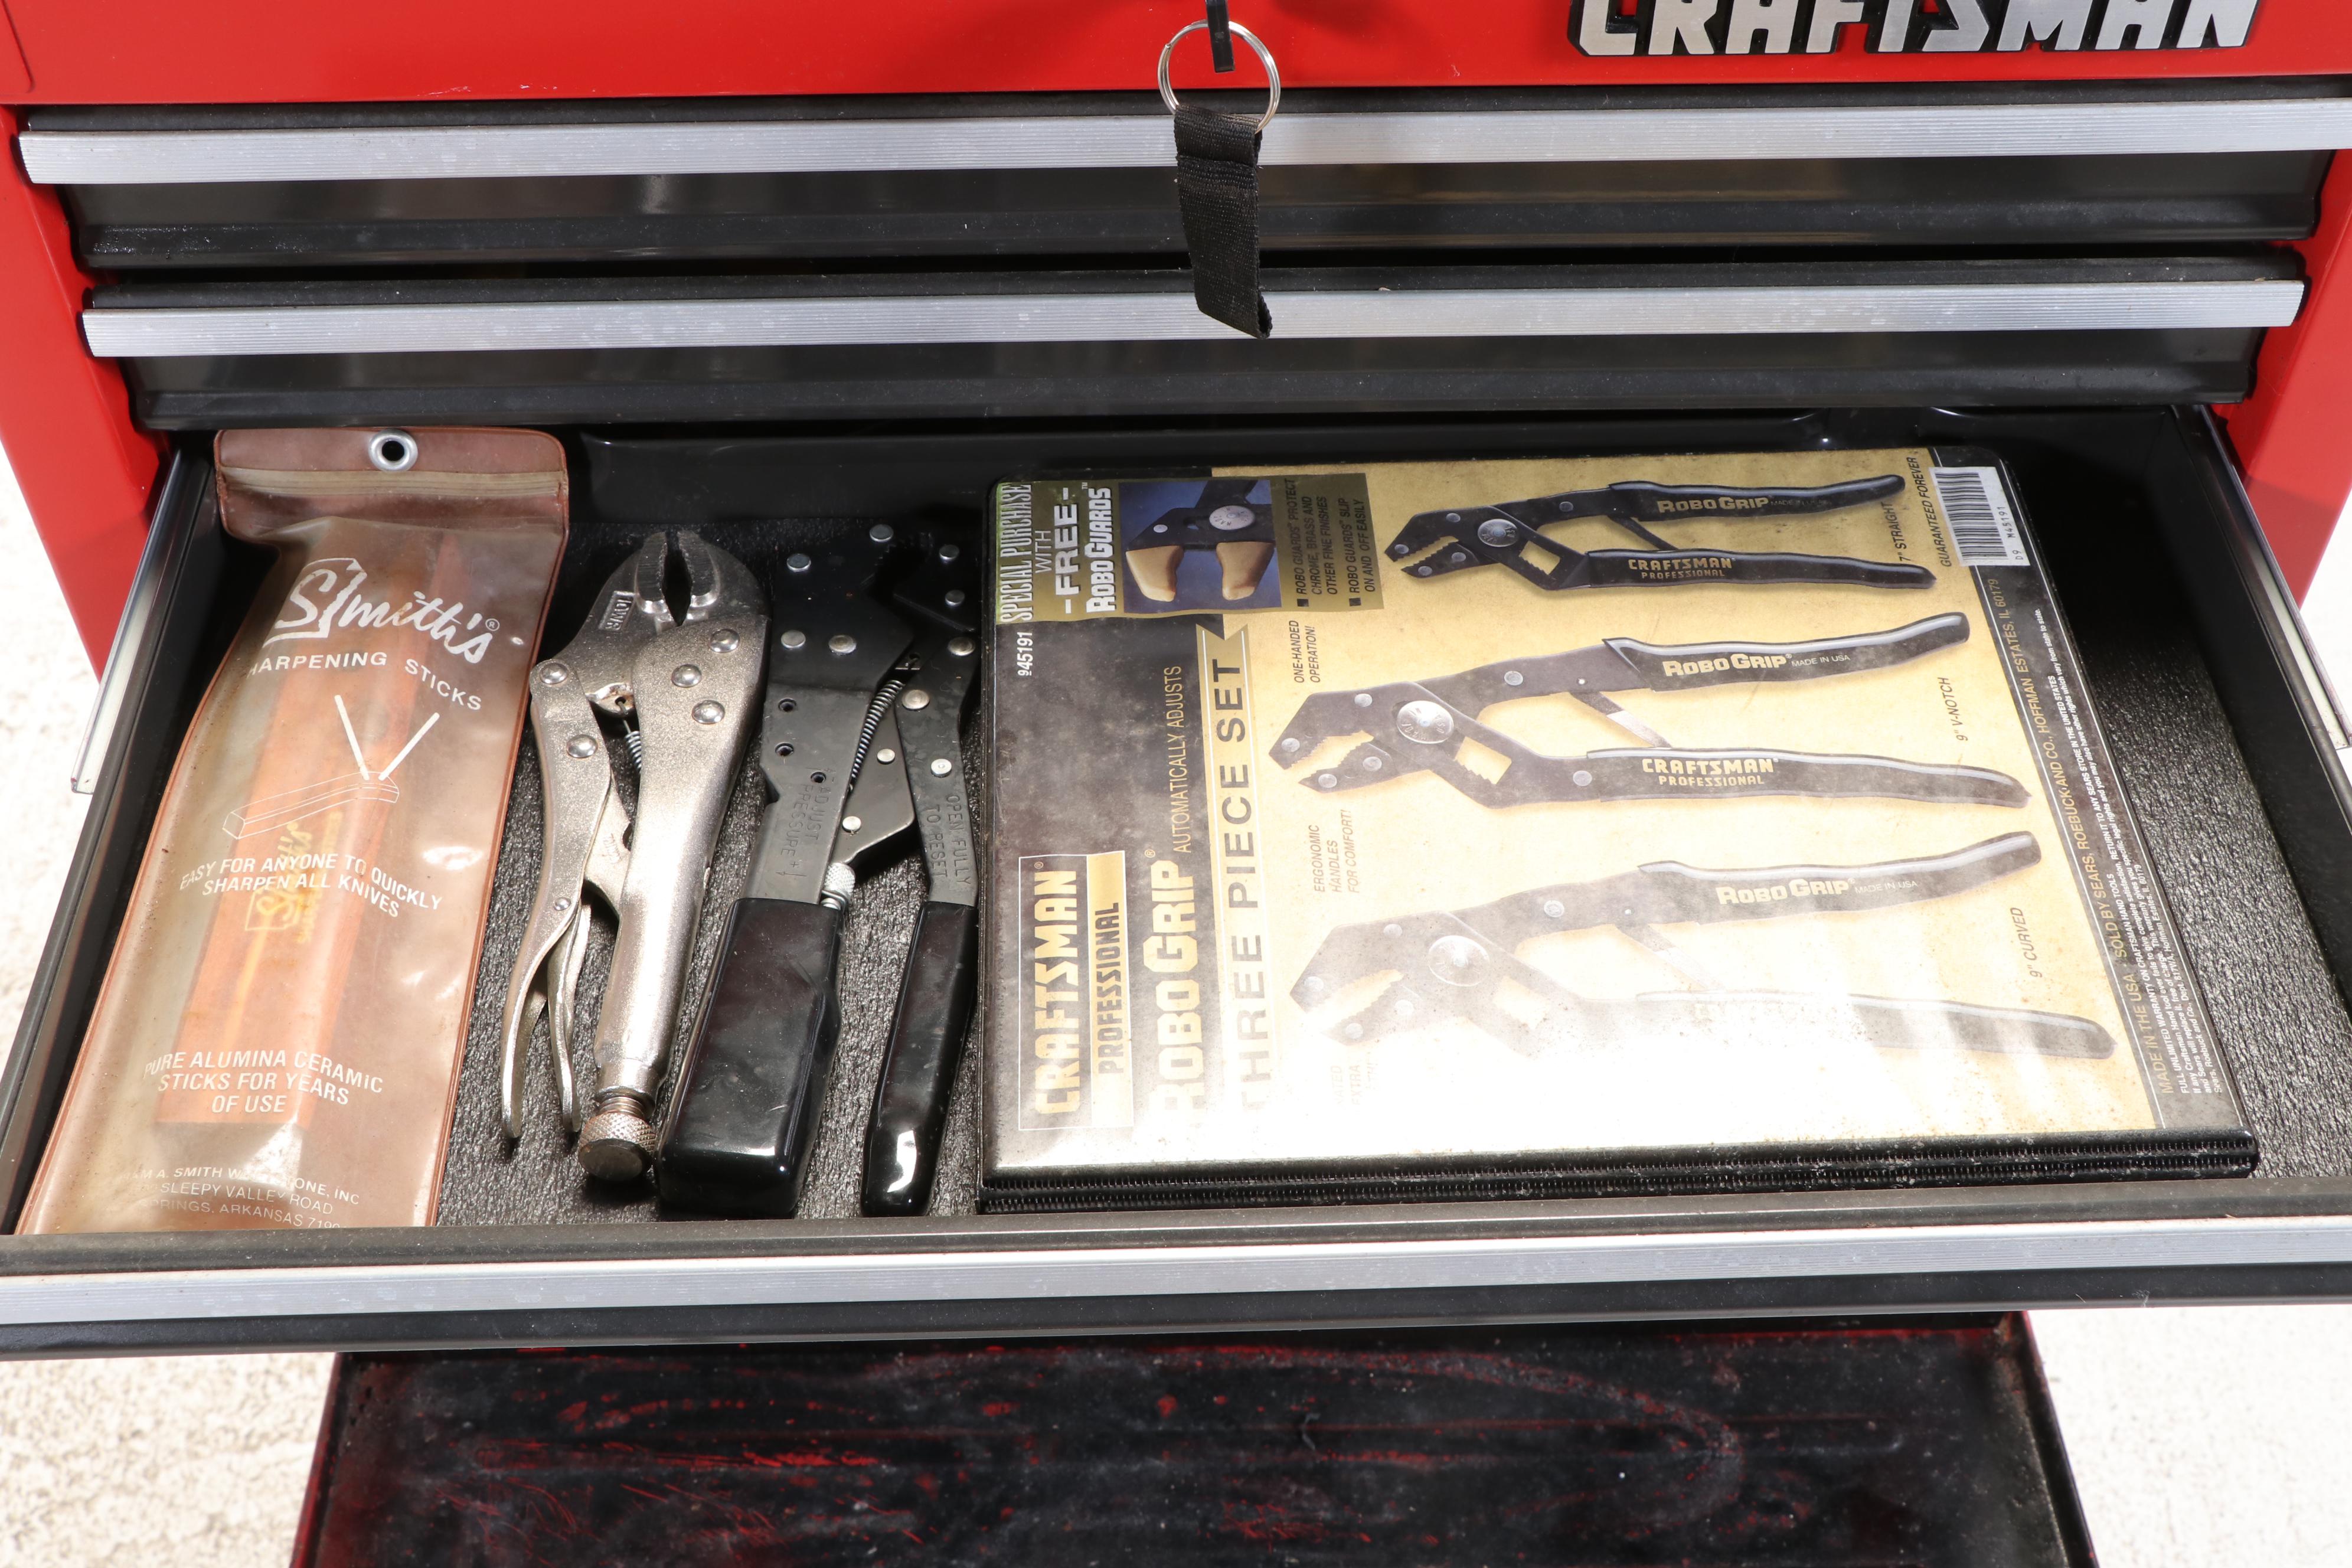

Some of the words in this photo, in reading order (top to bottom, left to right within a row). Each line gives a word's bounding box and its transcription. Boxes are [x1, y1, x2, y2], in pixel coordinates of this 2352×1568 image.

[1570, 0, 2256, 56] CRAFTSMAN
[1906, 457, 1930, 498] FOREVER
[1285, 478, 1298, 520] PROTECT
[1302, 496, 1313, 516] AND
[1338, 498, 1350, 518] SLIP
[1353, 499, 1367, 531] EASILY
[1001, 482, 1032, 557] PURCHASE
[1084, 488, 1113, 558] GUARDS
[1317, 496, 1331, 536] FINISHES
[1883, 502, 1907, 550] STRAIGHT
[1998, 506, 2016, 538] M45191
[1304, 518, 1317, 550] BRASS
[1321, 538, 1334, 560] FINE
[1358, 533, 1370, 551] OFF
[1922, 500, 1952, 567] GUARANTEED
[1035, 531, 1052, 573] WITH
[1361, 556, 1374, 576] AND
[1628, 558, 1733, 571] CRAFTSMAN
[2013, 550, 2024, 560] D9
[1086, 560, 1116, 613] ROBO
[1294, 568, 1307, 595] ROBO
[1308, 553, 1322, 595] CHROME,
[1325, 563, 1338, 594] OTHER
[1347, 566, 1360, 593] ROBO
[1364, 578, 1376, 592] ON
[1641, 570, 1725, 579] PROFESSIONAL
[1000, 560, 1033, 623] SPECIAL
[1988, 579, 2005, 606] 60179
[264, 558, 493, 664] Smith's
[1017, 632, 1033, 676] 945191
[1289, 620, 1305, 683] ONE-HANDED
[1304, 626, 1321, 683] OPERATION!
[1792, 658, 1818, 667] MADE
[1831, 654, 1851, 662] USA
[2003, 624, 2028, 672] ESTATES,
[247, 652, 387, 677] HARPENING
[405, 659, 481, 711] STICKS
[1164, 665, 1184, 729] ADJUSTS
[2047, 675, 2062, 700] STATES
[1212, 659, 1246, 743] SET
[1938, 677, 1963, 726] V-NOTCH
[2021, 678, 2049, 732] HOFFMAN
[2057, 701, 2070, 724] UNITED
[1954, 729, 1968, 741] 9"
[2065, 727, 2075, 739] THE
[1642, 758, 1774, 775] CRAFTSMAN
[2050, 762, 2067, 786] AND
[2073, 749, 2087, 770] STORE
[1167, 733, 1191, 854] AUTOMATICALLY
[1658, 776, 1765, 787] PROFESSIONAL
[2082, 772, 2095, 795] SEARS
[780, 784, 814, 856] PRESSURE
[805, 787, 831, 840] ADJUST
[926, 804, 941, 823] TO
[946, 795, 964, 830] OPEN
[2059, 790, 2089, 848] ROEBUCK
[2090, 797, 2101, 811] ANY
[2096, 812, 2105, 821] TO
[1220, 764, 1258, 908] PIECE
[1340, 809, 1358, 867] COMFORT!
[2102, 831, 2118, 859] RETURN
[929, 833, 948, 877] RESET
[953, 840, 971, 884] FULLY
[1308, 825, 1326, 893] ERGONOMIC
[1328, 839, 1342, 893] HANDLES
[180, 861, 215, 890] EASY
[220, 858, 256, 874] FOR
[260, 854, 338, 872] ANYONE
[344, 855, 367, 876] TO
[371, 867, 443, 910] QUICKLY
[1347, 868, 1360, 894] FOR
[1854, 884, 1883, 894] MADE
[1884, 882, 1896, 890] IN
[1898, 880, 1917, 888] USA
[2082, 855, 2106, 897] SEARS,
[2106, 874, 2120, 897] TOOLS
[2134, 864, 2147, 884] 60179
[202, 874, 290, 896] SHARPEN
[295, 873, 331, 888] ALL
[338, 874, 399, 918] KNIVES
[2098, 902, 2113, 918] BY
[2115, 899, 2128, 919] HAND
[1143, 860, 1198, 972] GRIP
[2129, 903, 2145, 934] complete
[2010, 907, 2037, 962] CURVED
[2105, 923, 2126, 956] SOLD
[2124, 922, 2145, 967] CRAFTSMAN
[2141, 936, 2152, 950] give
[2157, 922, 2171, 951] Hoffman
[2027, 965, 2042, 978] 9"
[2140, 970, 2150, 981] ON
[2150, 962, 2160, 976] fails
[1034, 871, 1080, 1115] CRAFTSMAN
[1095, 902, 1124, 1075] PROFESSIONAL
[2124, 975, 2141, 1001] USA
[2156, 978, 2165, 994] ever
[2160, 995, 2171, 1009] tool
[2134, 1006, 2151, 1030] THE
[2144, 983, 2165, 1026] WARRANTY
[2166, 1011, 2179, 1030] Hand
[1231, 935, 1271, 1111] THREE
[2189, 1018, 2200, 1032] and
[2144, 1035, 2158, 1048] IN
[2161, 1029, 2181, 1070] UNLIMITED
[2175, 1032, 2193, 1070] Craftsman
[2196, 1034, 2212, 1067] Roebuck
[143, 1051, 187, 1080] PURE
[189, 1050, 286, 1069] ALUMINA
[2150, 1053, 2173, 1093] MADE
[2189, 1073, 2199, 1086] any
[158, 1072, 231, 1092] STICKS
[237, 1072, 277, 1090] FOR
[286, 1073, 349, 1106] YEARS
[2177, 1074, 2189, 1093] FULL
[211, 1095, 240, 1113] OF
[245, 1095, 288, 1113] USE
[174, 1167, 223, 1178] SMITH
[160, 1182, 221, 1196] SLEEPY
[290, 1194, 334, 1215] ROAD
[220, 1204, 303, 1227] ARKANSAS
